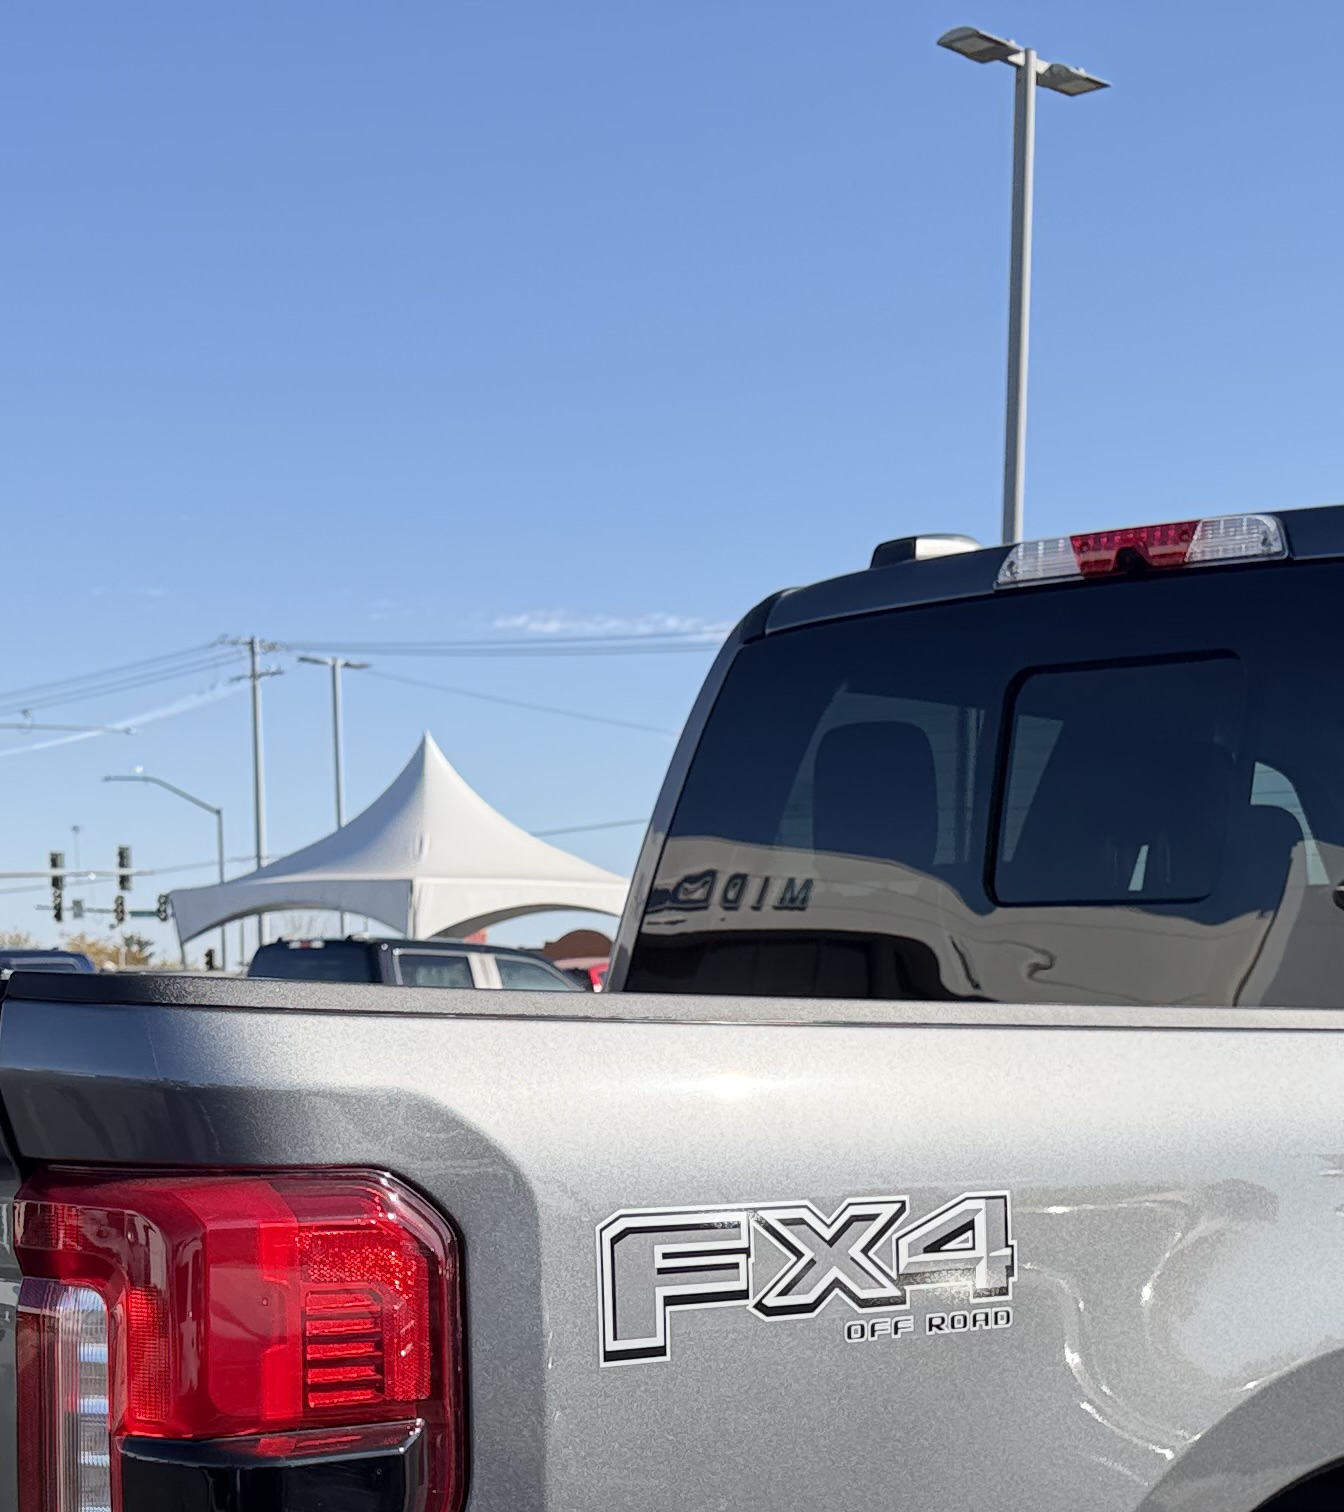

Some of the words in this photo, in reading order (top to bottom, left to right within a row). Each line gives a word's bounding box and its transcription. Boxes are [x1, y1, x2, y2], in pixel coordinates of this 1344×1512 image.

[596, 1190, 1017, 1367] FX4
[845, 1315, 914, 1343] OFF
[925, 1306, 1013, 1334] ROAD
